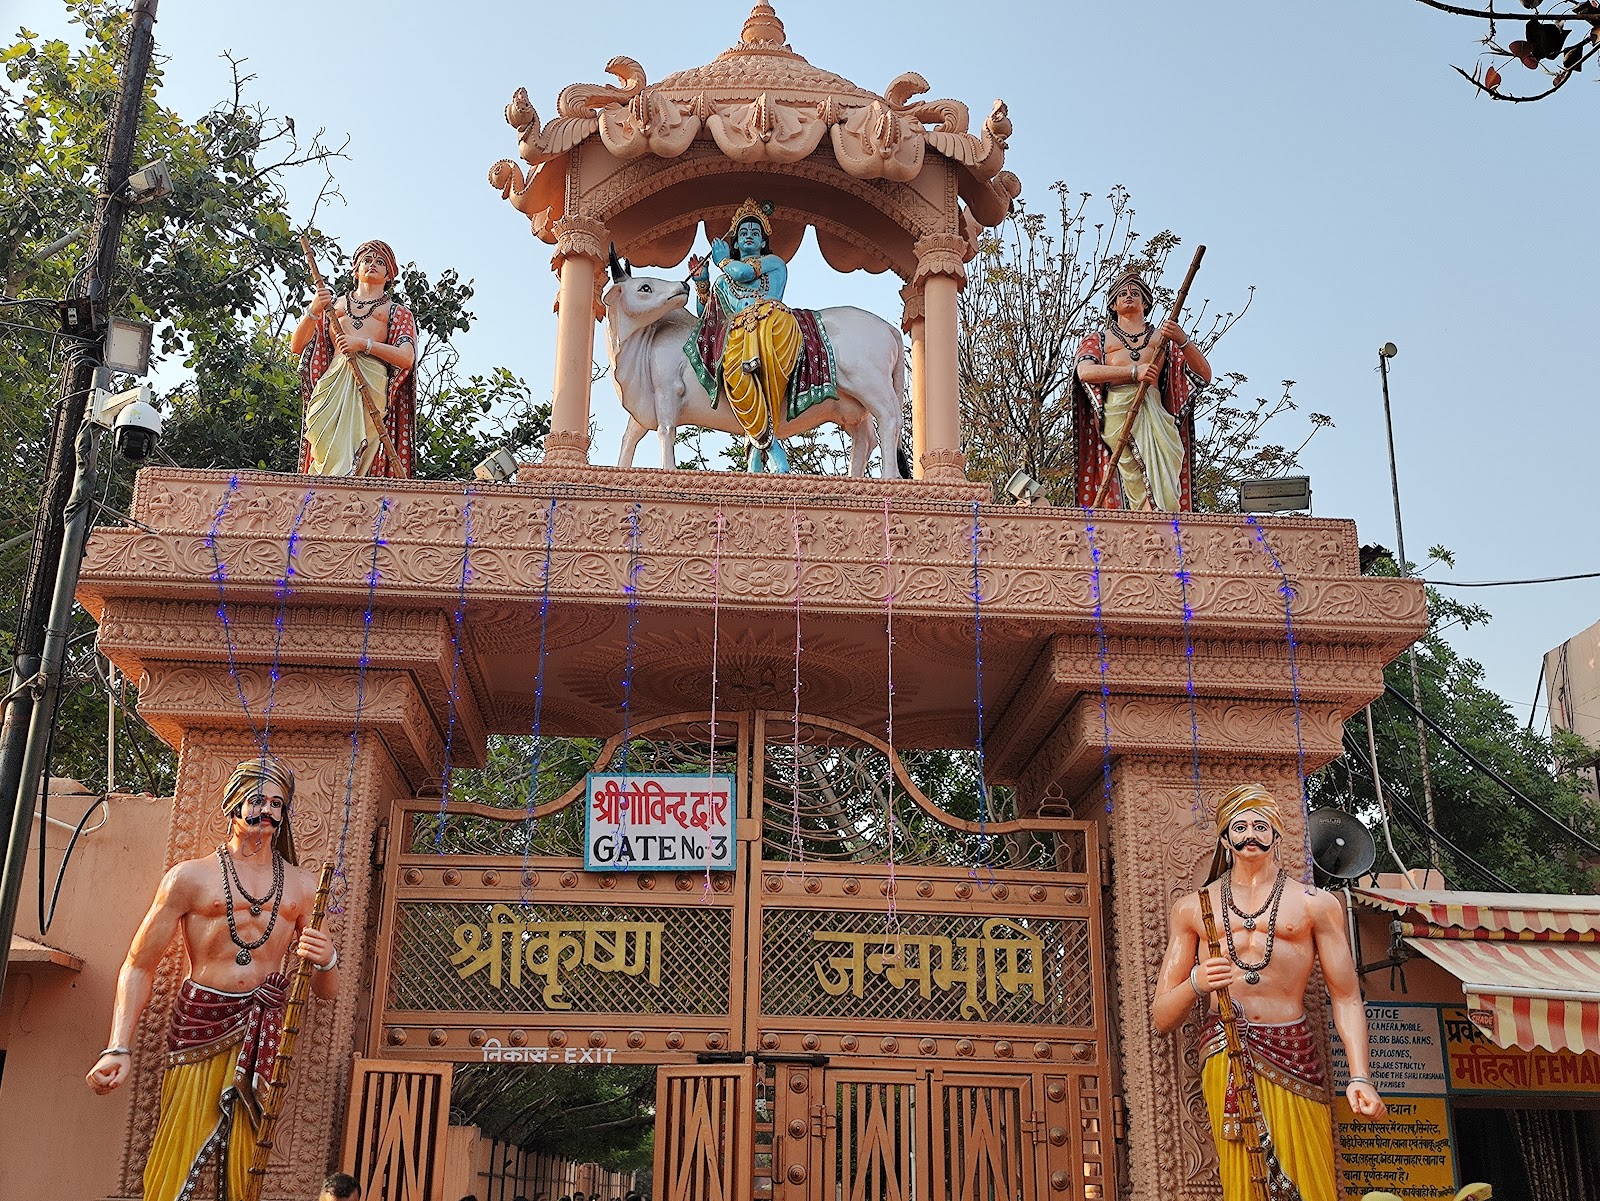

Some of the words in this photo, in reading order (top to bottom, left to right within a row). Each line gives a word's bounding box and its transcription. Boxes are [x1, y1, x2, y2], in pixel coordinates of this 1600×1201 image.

[593, 835, 676, 863] GATE
[1365, 1008, 1399, 1019] OTICE
[481, 1038, 550, 1063] निकास
[564, 1047, 617, 1064] EXIT
[1395, 1062, 1426, 1070] STRICTLY
